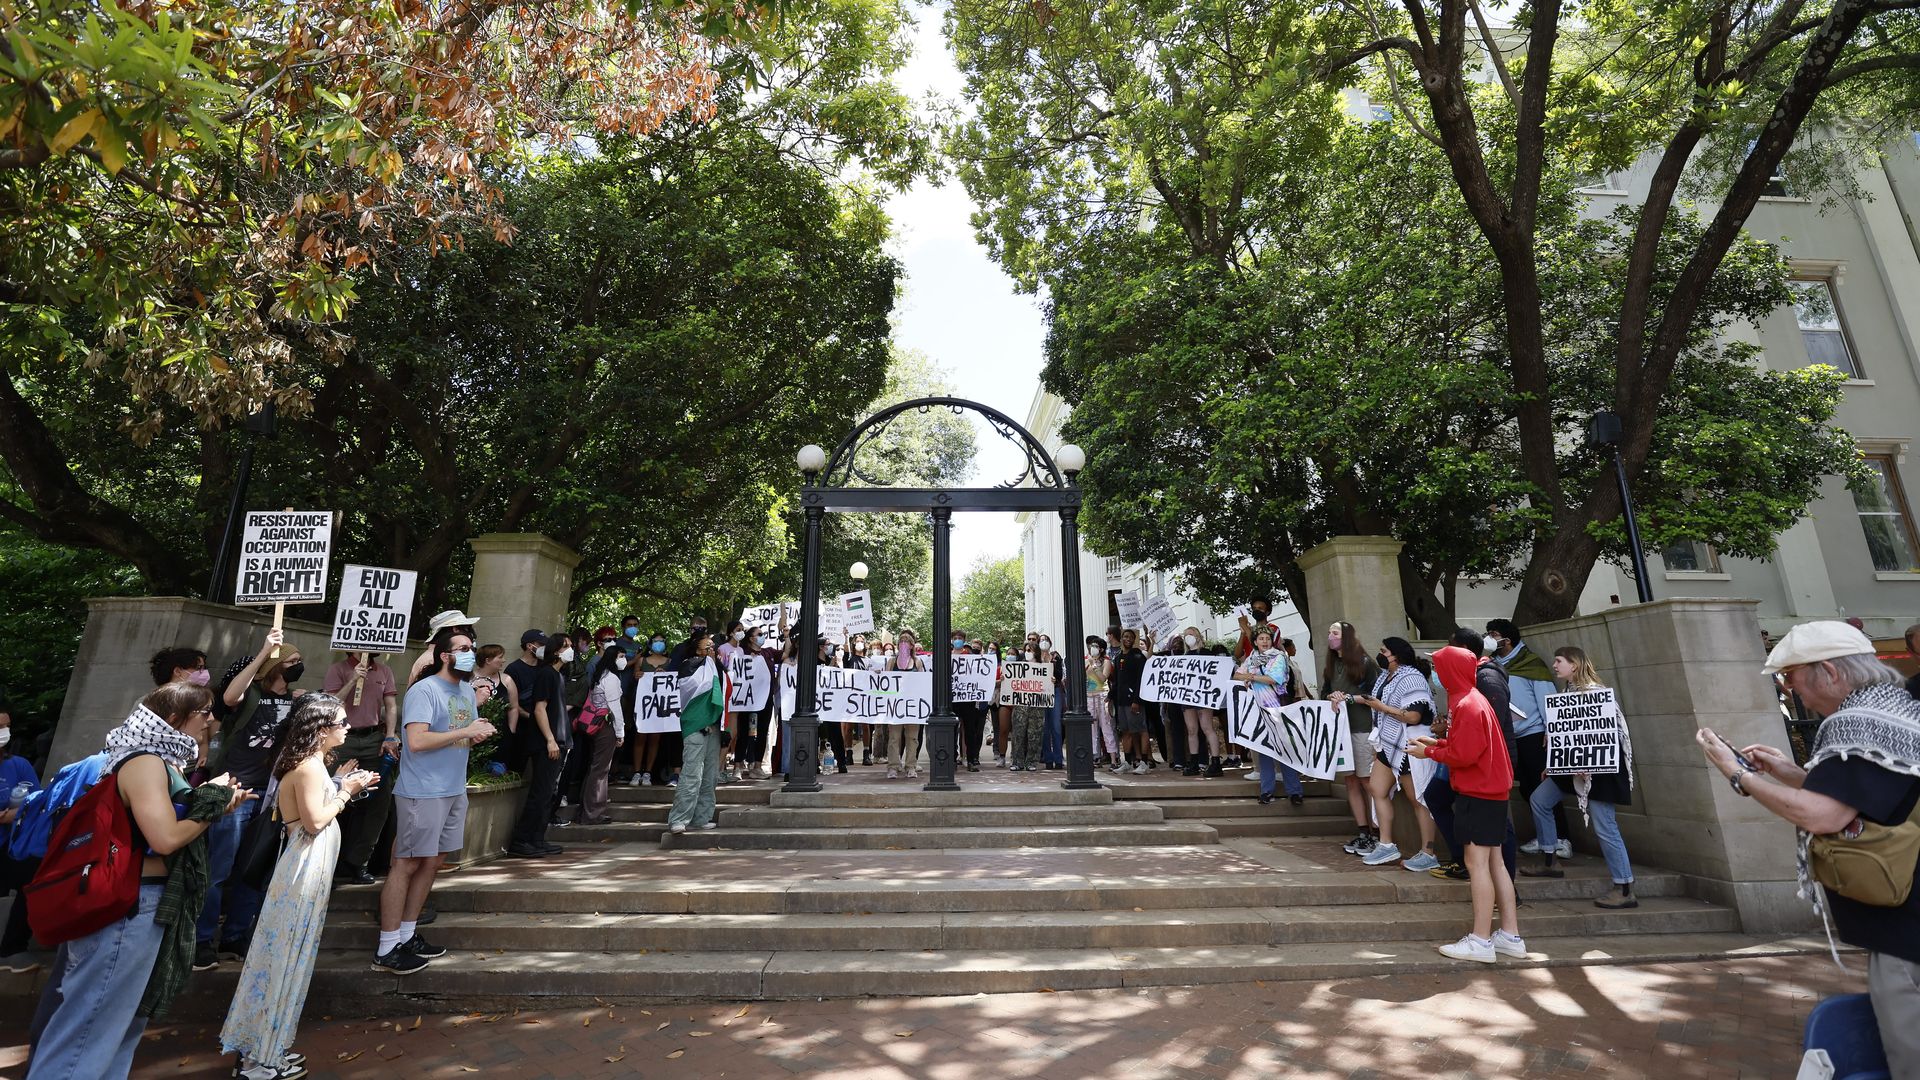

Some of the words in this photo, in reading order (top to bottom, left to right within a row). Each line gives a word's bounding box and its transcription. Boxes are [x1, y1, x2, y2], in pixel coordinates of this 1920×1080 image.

[249, 515, 328, 526] RESISTANCE
[259, 528, 315, 540] AGAINST
[245, 541, 326, 553] OCCUPATION
[245, 559, 259, 570] IS
[262, 558, 271, 570] A
[274, 557, 323, 570] HUMAN
[242, 570, 321, 594] RIGHT!
[360, 569, 400, 590] END
[359, 589, 393, 609] ALL
[340, 609, 372, 627] U.S.
[377, 613, 406, 629] AID
[747, 607, 778, 622] STOP
[846, 619, 870, 627] PALESTINE
[336, 627, 352, 640] TO
[355, 628, 403, 643] ISRAEL!
[1005, 664, 1029, 678] STOP
[1032, 667, 1047, 676] THE
[1152, 658, 1167, 668] DO
[1169, 658, 1187, 668] WE
[1187, 659, 1219, 675] HAVE
[818, 670, 863, 692] WILL
[870, 676, 902, 692] NOT
[1011, 680, 1043, 691] GENOCIDE
[1147, 673, 1155, 686] A
[1158, 671, 1196, 685] RIGHT
[1198, 676, 1212, 690] TO
[952, 690, 986, 701] PROTEST
[1012, 692, 1054, 706] PALESTINIANS
[1157, 686, 1220, 708] PROTEST?
[1547, 691, 1612, 708] RESISTANCE
[846, 693, 930, 719] SILENCED
[1557, 705, 1602, 720] AGAINST
[1548, 717, 1615, 733] OCCUPATION
[1550, 736, 1561, 748] IS
[1564, 735, 1571, 746] A
[1573, 732, 1616, 746] HUMAN
[1550, 745, 1615, 767] RIGHT!
